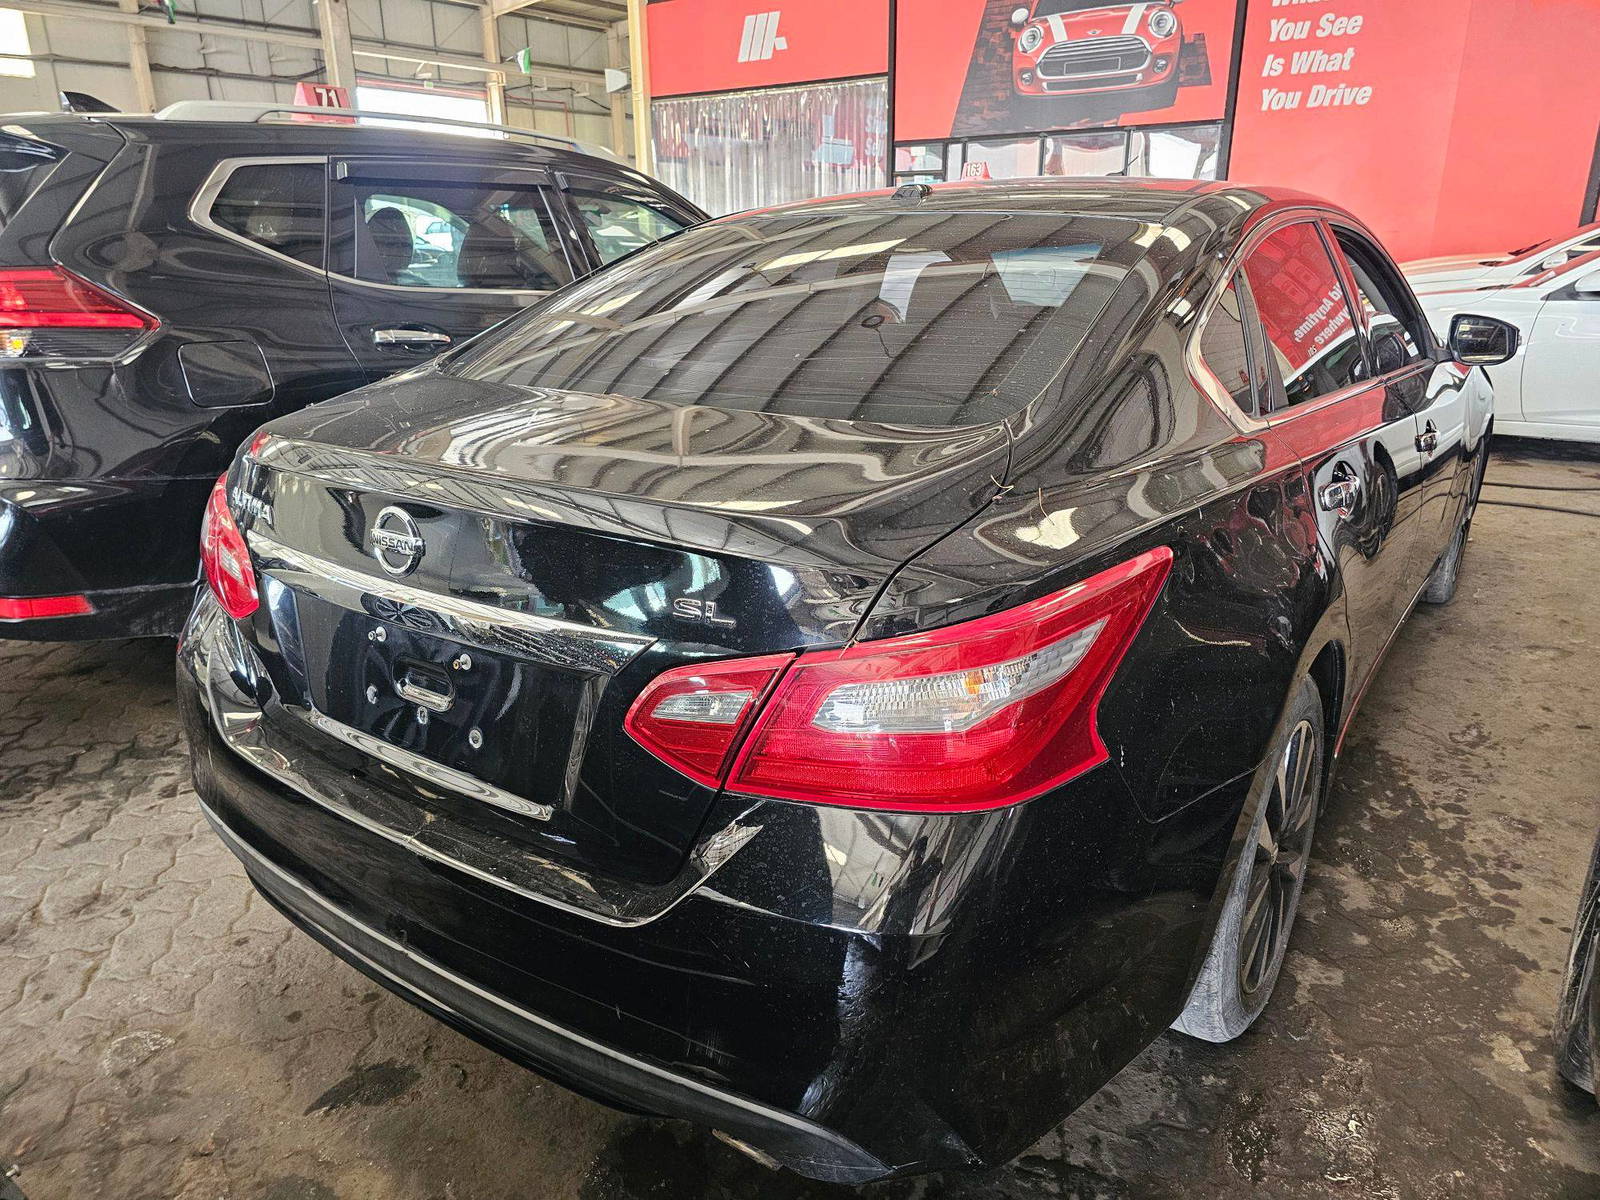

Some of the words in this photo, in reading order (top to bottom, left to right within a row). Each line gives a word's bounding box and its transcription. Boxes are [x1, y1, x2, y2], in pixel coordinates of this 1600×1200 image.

[1269, 17, 1312, 43] You
[1315, 12, 1364, 38] See
[1261, 54, 1285, 77] Is
[1290, 47, 1355, 75] What
[313, 87, 341, 108] 71
[1261, 88, 1303, 111] You
[1306, 83, 1373, 108] Drive
[966, 162, 982, 177] 163
[370, 531, 414, 552] NISSAN
[672, 597, 737, 629] SL
